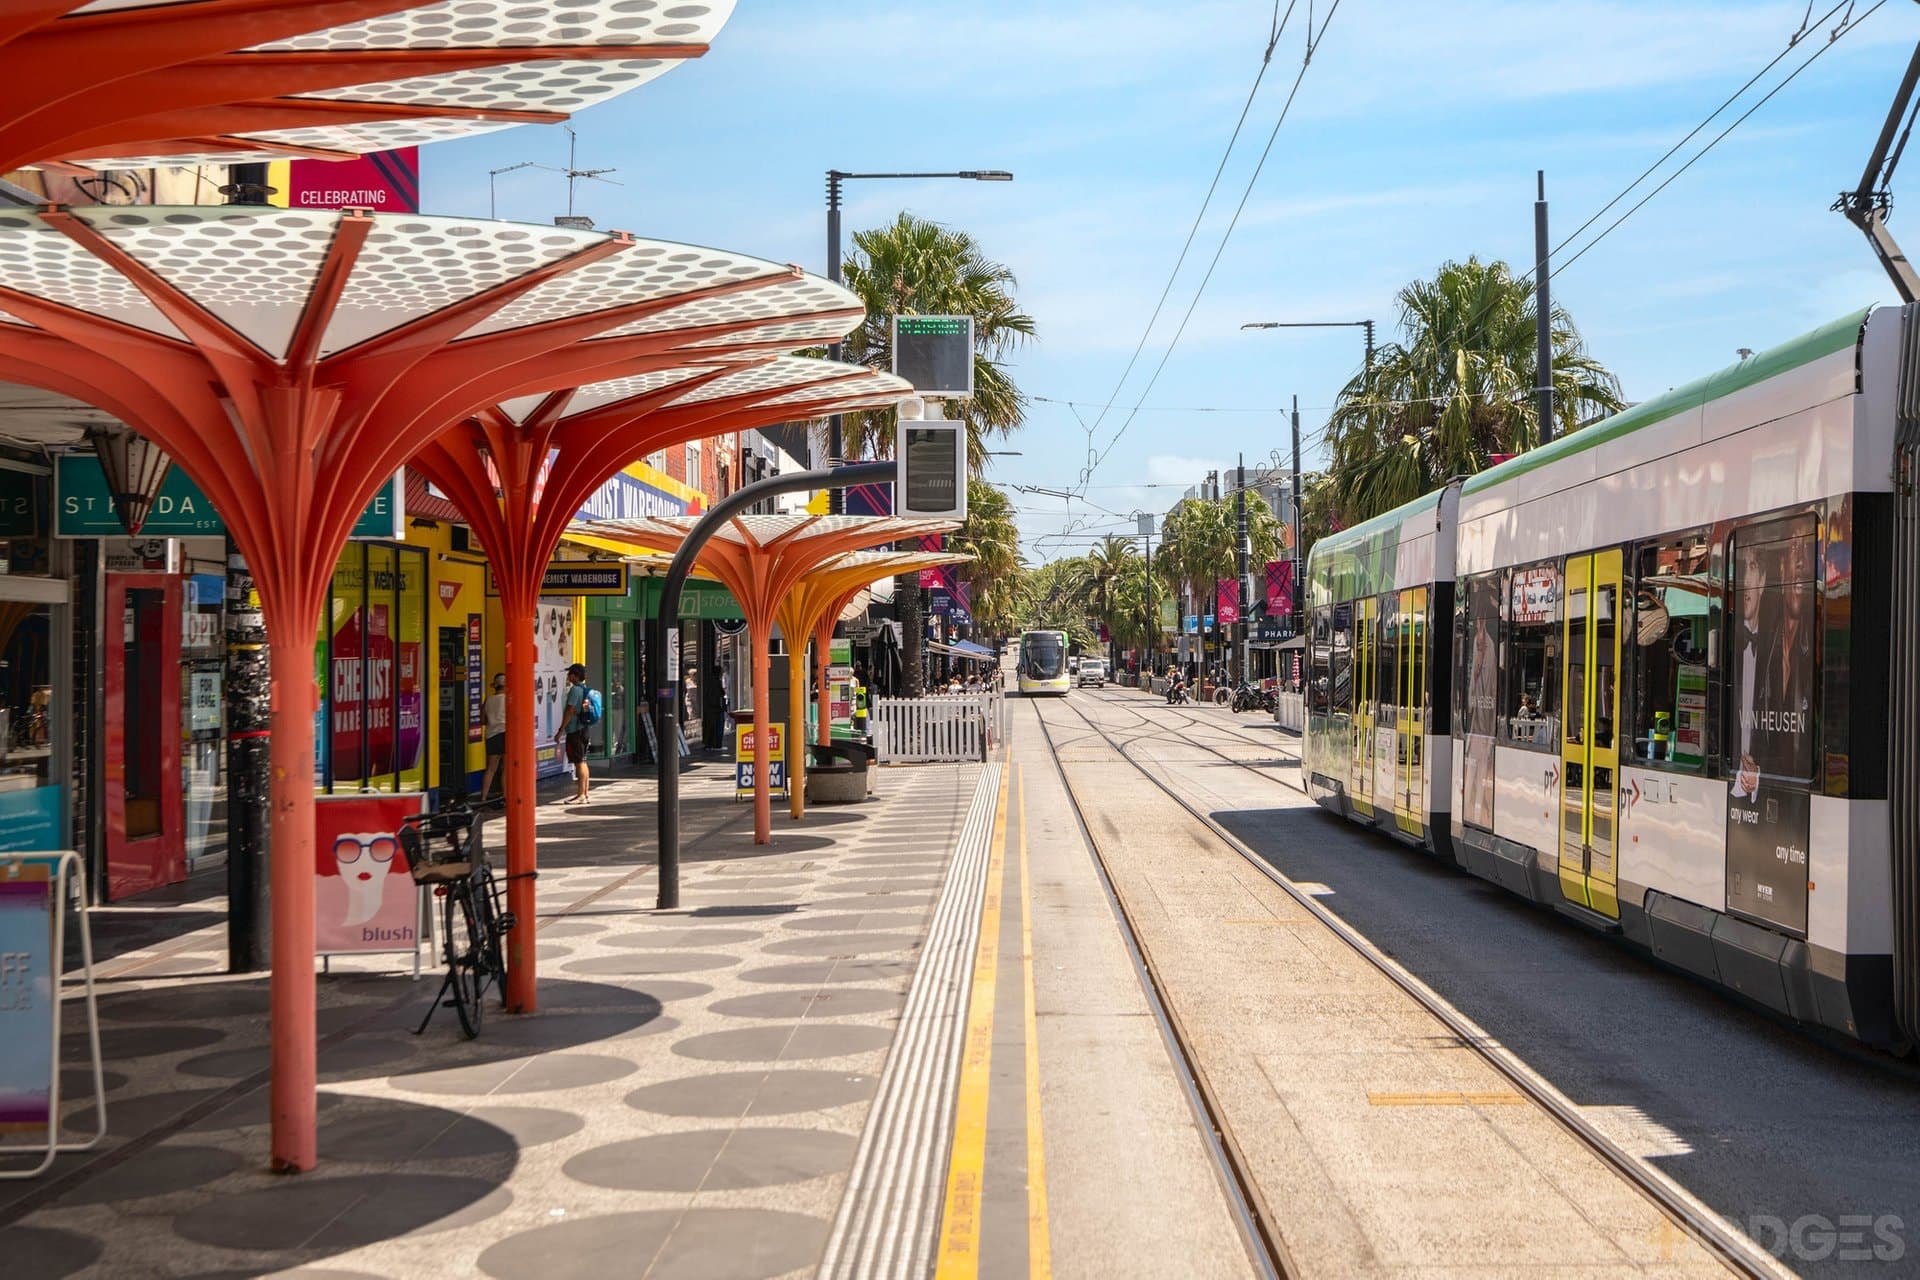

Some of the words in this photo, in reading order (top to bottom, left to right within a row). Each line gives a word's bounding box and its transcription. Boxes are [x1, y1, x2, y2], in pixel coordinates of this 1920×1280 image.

[300, 190, 386, 204] CELEBRATING
[196, 520, 218, 528] EST
[571, 573, 617, 584] WAREHOUSE
[335, 708, 389, 733] WAREOUSE
[1761, 710, 1806, 733] HEUSEN
[743, 735, 779, 745] CHST
[742, 764, 780, 775] NW
[740, 774, 781, 787] ON
[1730, 807, 1742, 824] any
[1742, 809, 1759, 824] wear
[1776, 845, 1789, 864] any
[1789, 844, 1806, 864] time
[362, 927, 413, 942] blush
